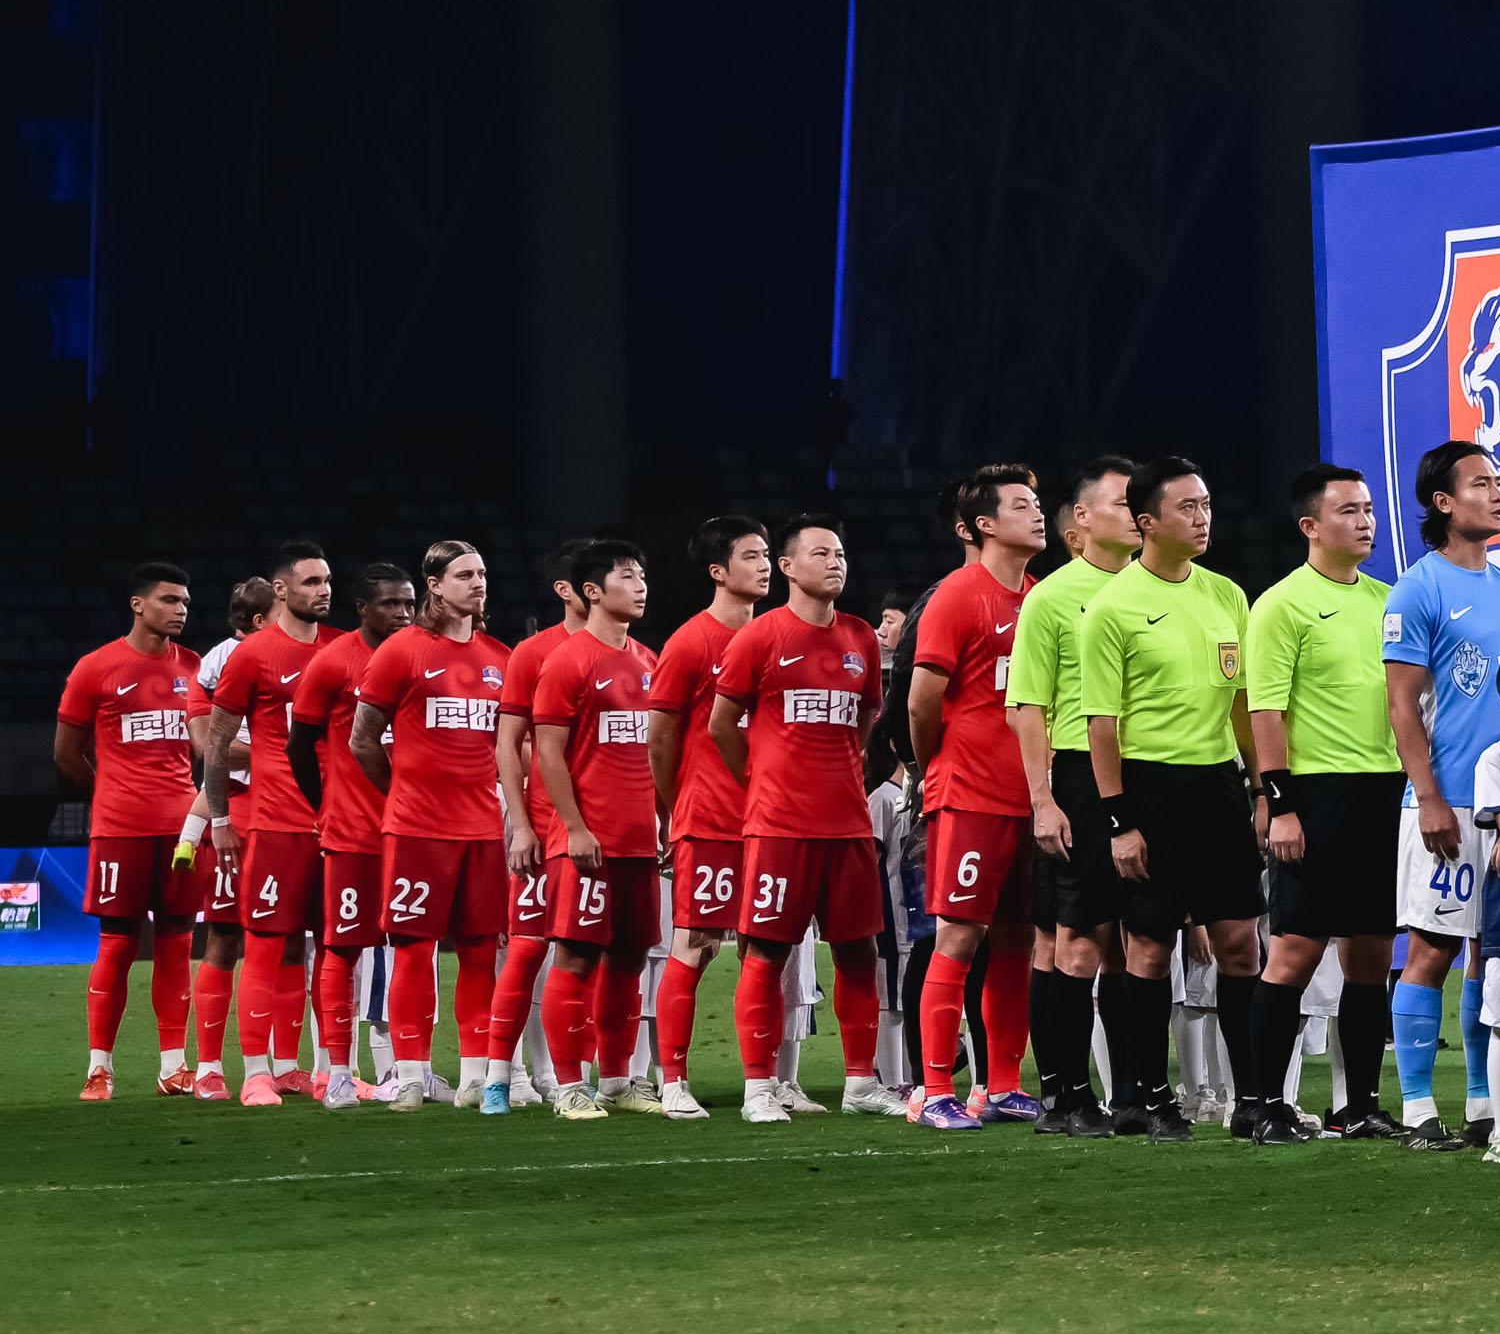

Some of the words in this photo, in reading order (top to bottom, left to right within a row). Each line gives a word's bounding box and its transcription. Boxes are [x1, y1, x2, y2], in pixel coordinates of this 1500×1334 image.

[99, 860, 119, 894] 11
[693, 865, 734, 902] 26
[957, 850, 981, 888] 6
[1429, 858, 1474, 903] 40
[259, 874, 279, 907] 4
[340, 887, 358, 919] 8
[389, 877, 430, 915] 22
[578, 876, 607, 915] 15
[753, 873, 788, 913] 31
